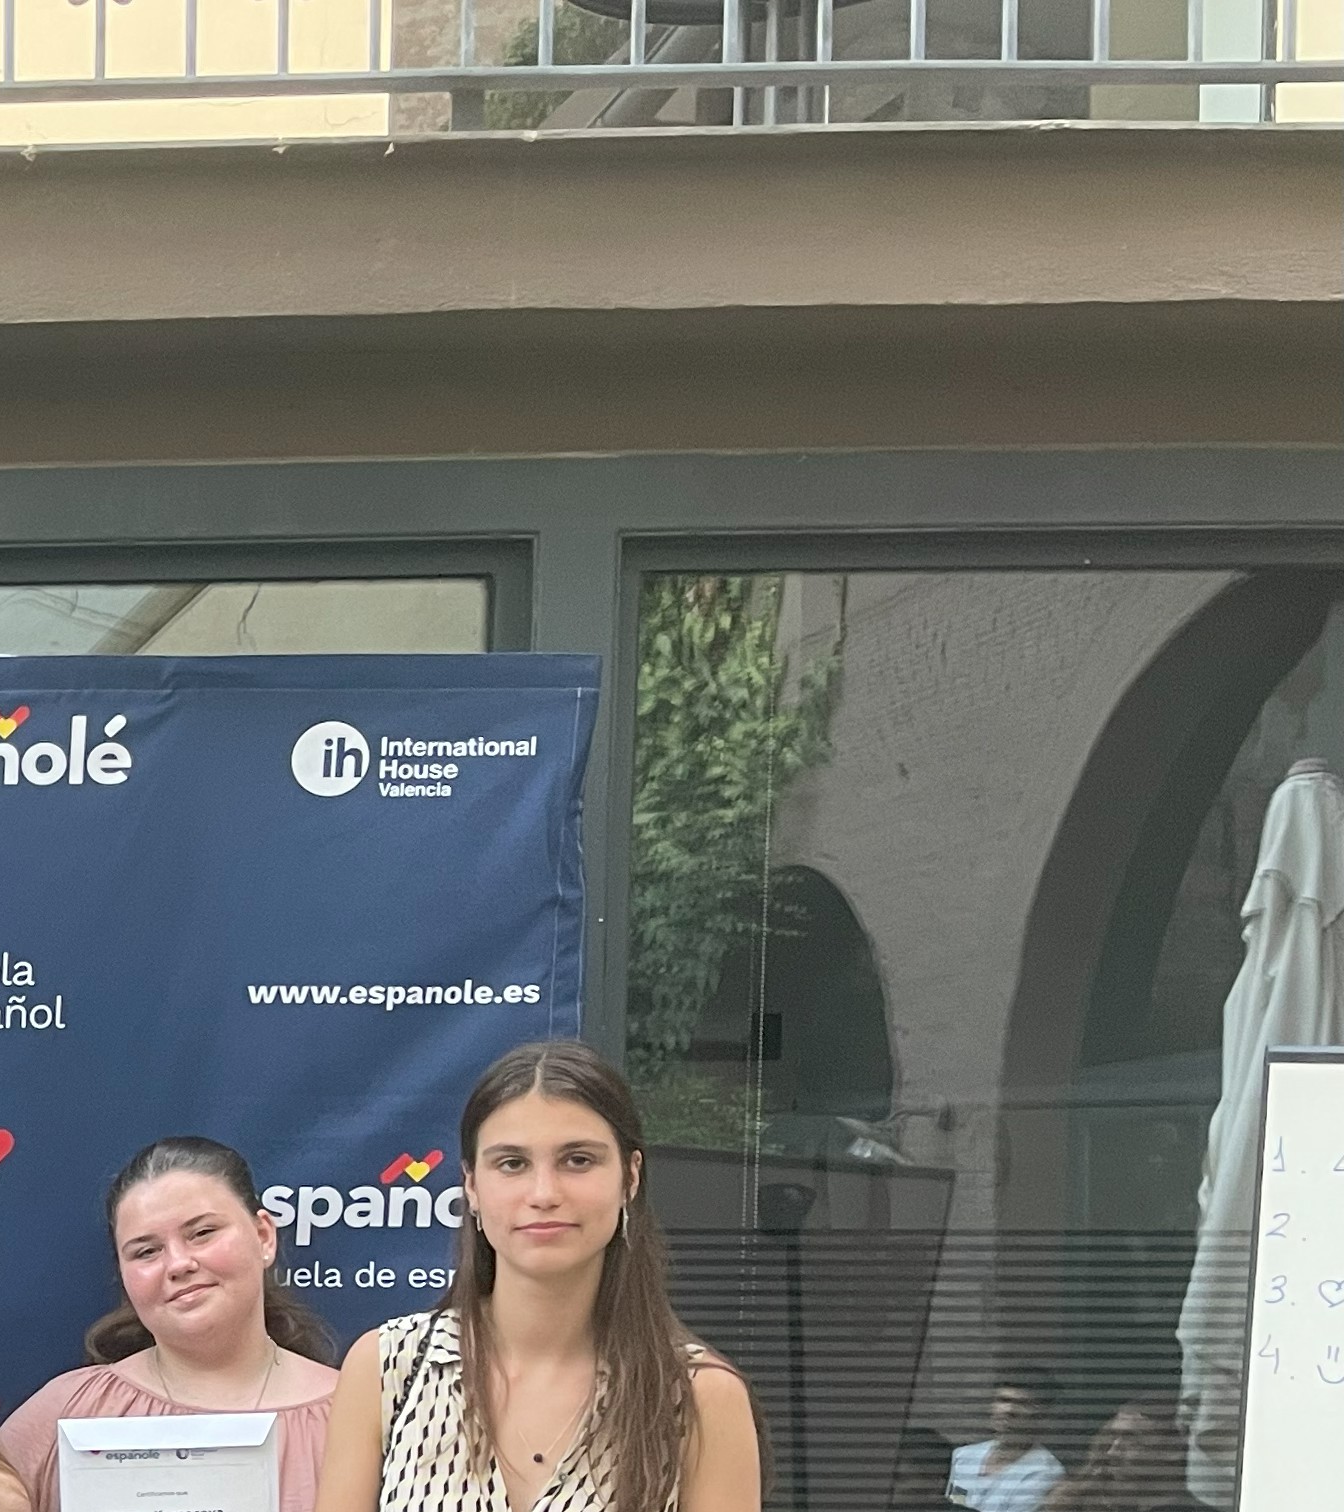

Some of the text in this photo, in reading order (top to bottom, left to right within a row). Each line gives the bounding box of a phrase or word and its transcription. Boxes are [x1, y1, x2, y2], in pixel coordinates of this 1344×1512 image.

[379, 734, 537, 758] International
[379, 758, 459, 781] House
[378, 781, 452, 798] Valencia
[247, 978, 540, 1011] www.espanole.es
[354, 1260, 397, 1288] de
